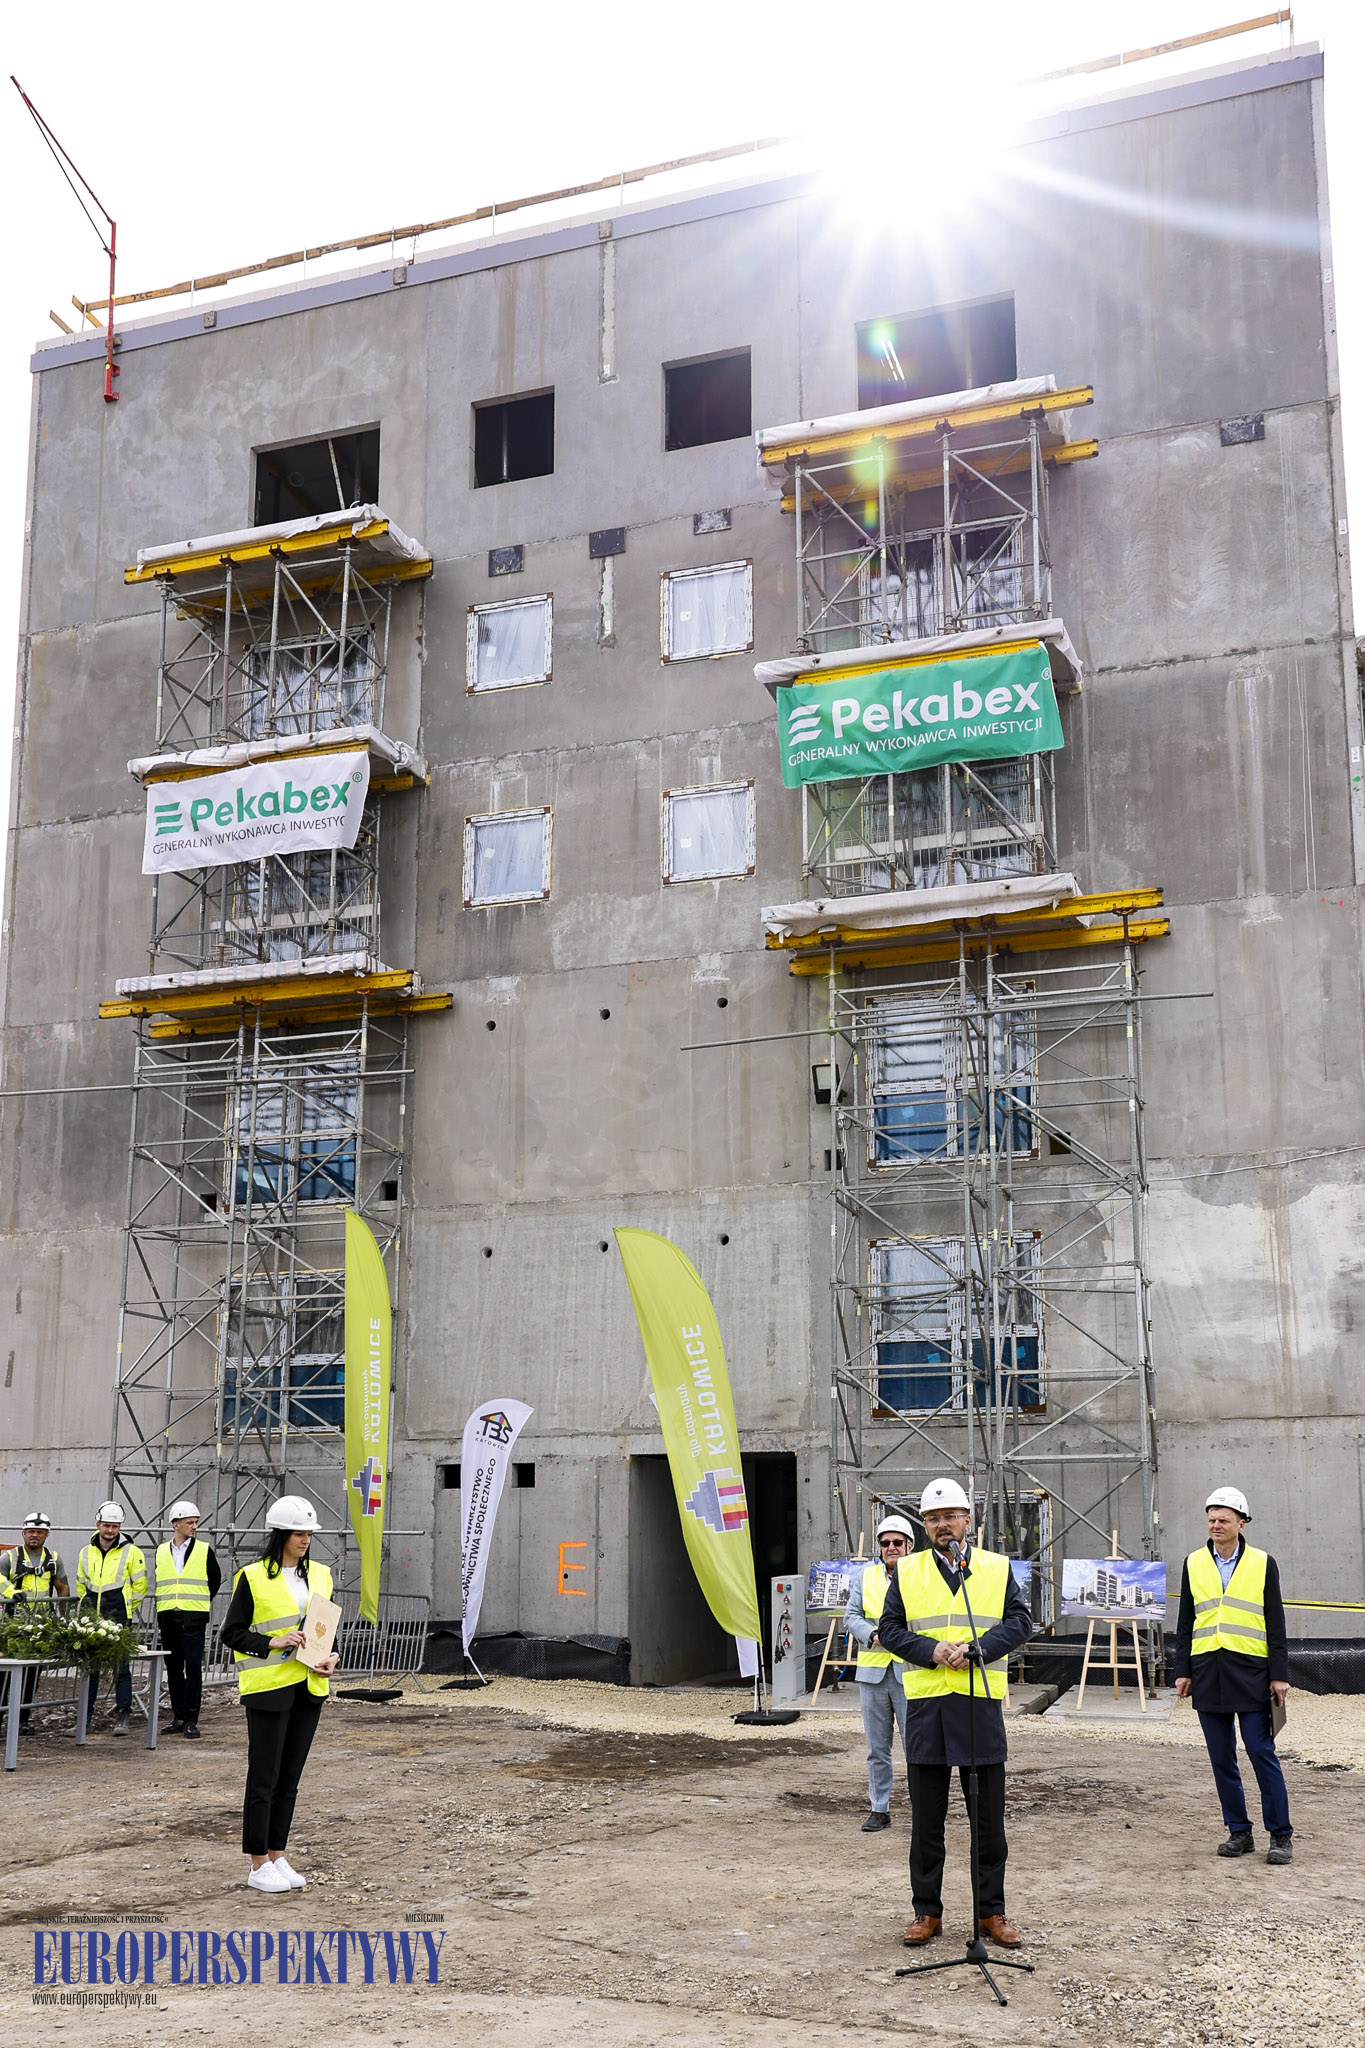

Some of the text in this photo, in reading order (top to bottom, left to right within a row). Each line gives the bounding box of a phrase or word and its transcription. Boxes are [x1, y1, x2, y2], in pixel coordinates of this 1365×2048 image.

[1152, 40, 1183, 53] TLC
[832, 680, 1041, 739] Pekabex
[788, 717, 1043, 767] GENERALNY WYKONAWCA INWESTYCJI
[190, 781, 351, 832] Pekabex
[152, 836, 214, 855] GENERALNY
[215, 823, 287, 846] WYKONAWCA
[480, 1412, 513, 1445] TBS
[474, 1458, 496, 1536] SPOŁECZNEGO
[557, 1541, 588, 1596] E
